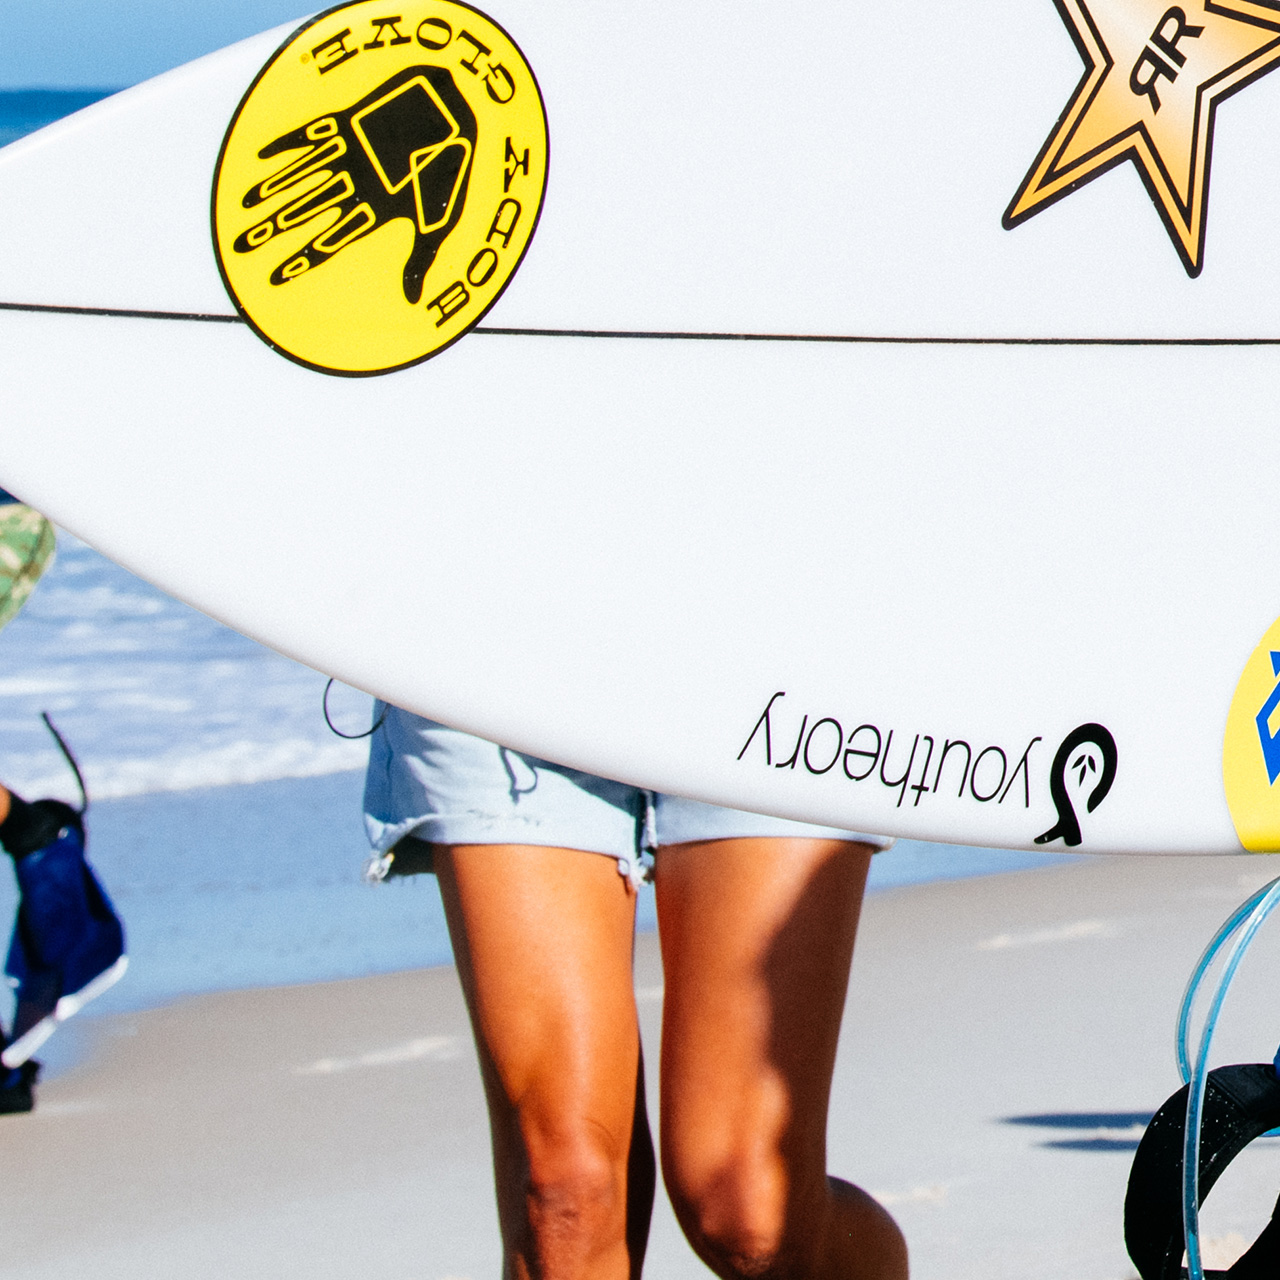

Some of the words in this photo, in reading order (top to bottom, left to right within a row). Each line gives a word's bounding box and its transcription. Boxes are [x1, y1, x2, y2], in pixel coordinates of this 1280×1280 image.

[310, 15, 517, 104] GLOVE
[426, 136, 530, 328] BODY
[737, 691, 1042, 808] youtheory
